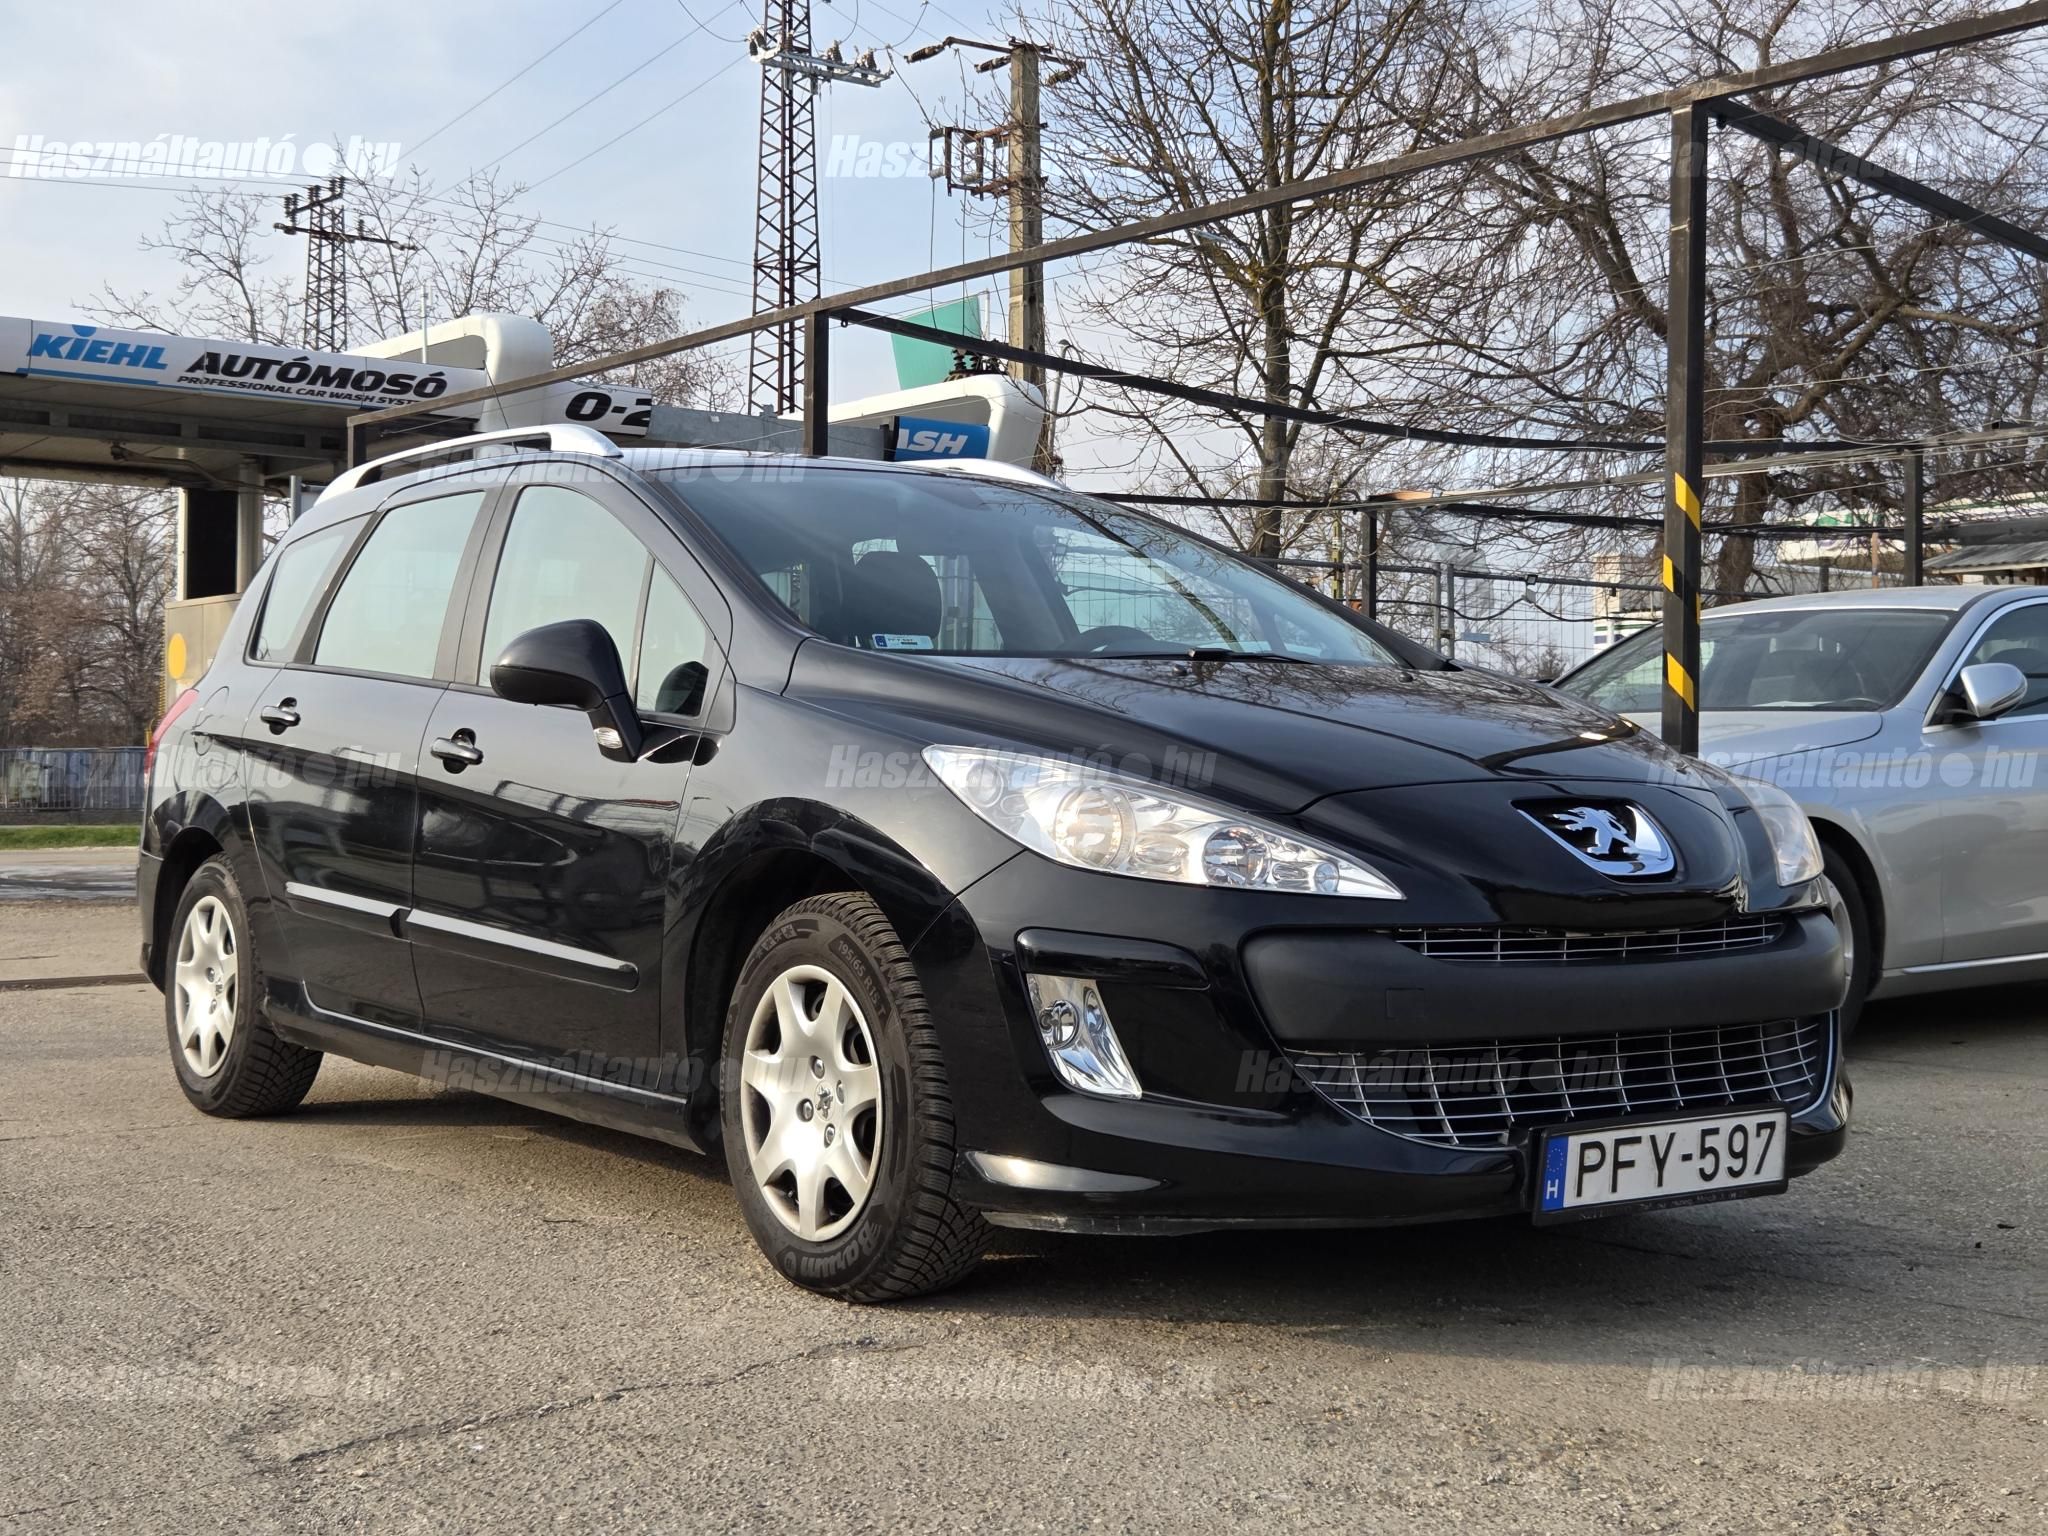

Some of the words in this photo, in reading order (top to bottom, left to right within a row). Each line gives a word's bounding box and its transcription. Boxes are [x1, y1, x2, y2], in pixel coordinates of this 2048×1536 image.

[177, 376, 292, 394] PROFESSIONAL
[296, 388, 327, 398] CAR
[329, 391, 375, 403] WASH
[375, 396, 420, 405] SYST
[186, 351, 447, 398] AUTÓMOSÓ
[1546, 1179, 1558, 1199] H
[1576, 1120, 1777, 1198] PFY-597
